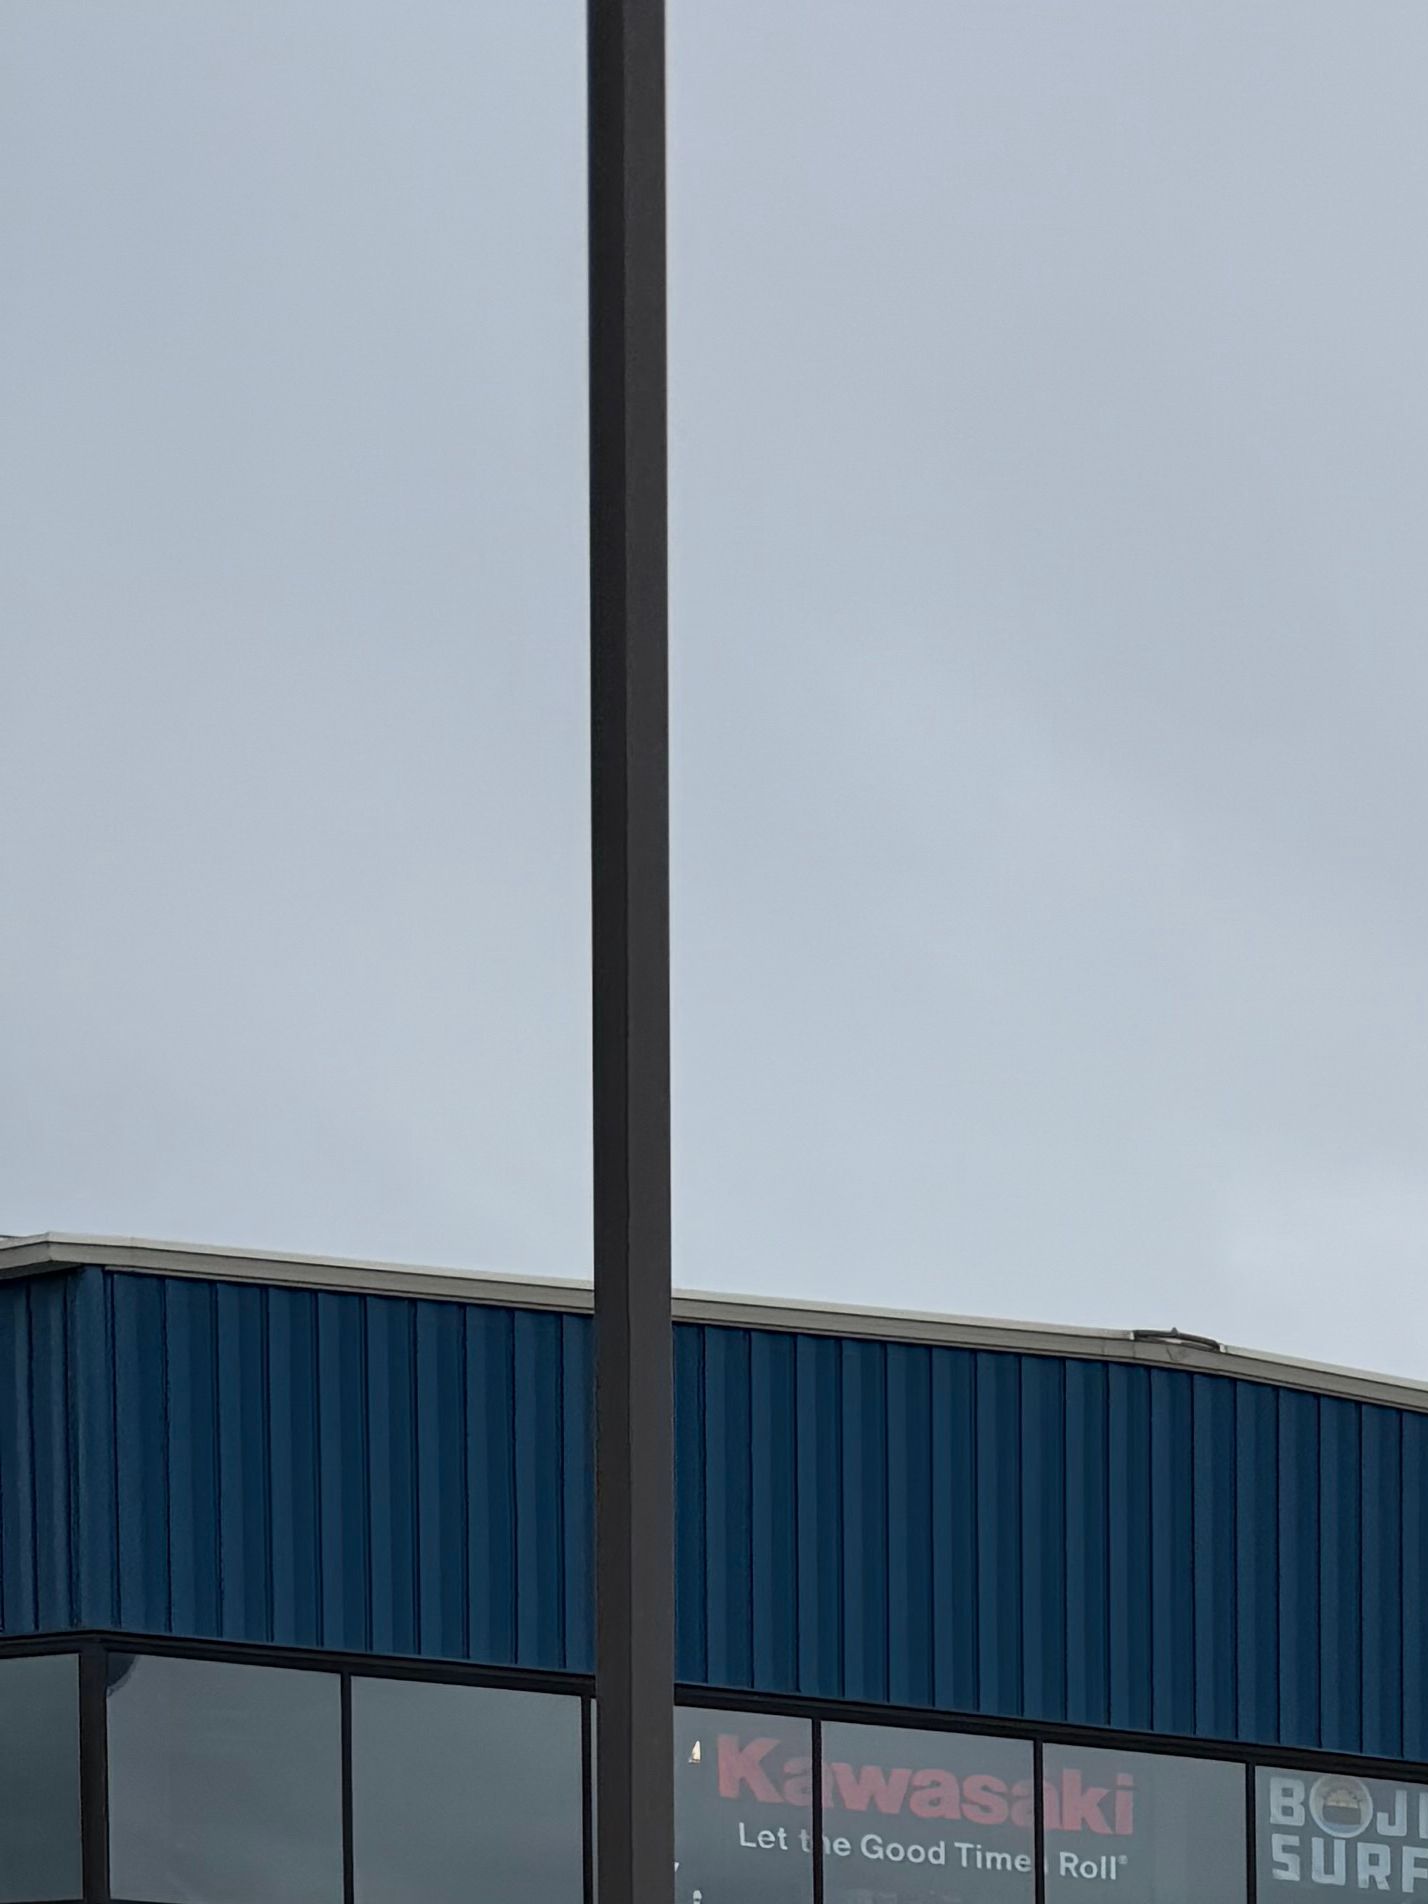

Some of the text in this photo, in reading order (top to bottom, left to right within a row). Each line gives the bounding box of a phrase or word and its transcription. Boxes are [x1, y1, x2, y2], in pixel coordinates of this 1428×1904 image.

[715, 1733, 1134, 1836] Kawasaki
[739, 1821, 788, 1850] Let
[861, 1834, 946, 1866] Good
[954, 1842, 1048, 1874] Time
